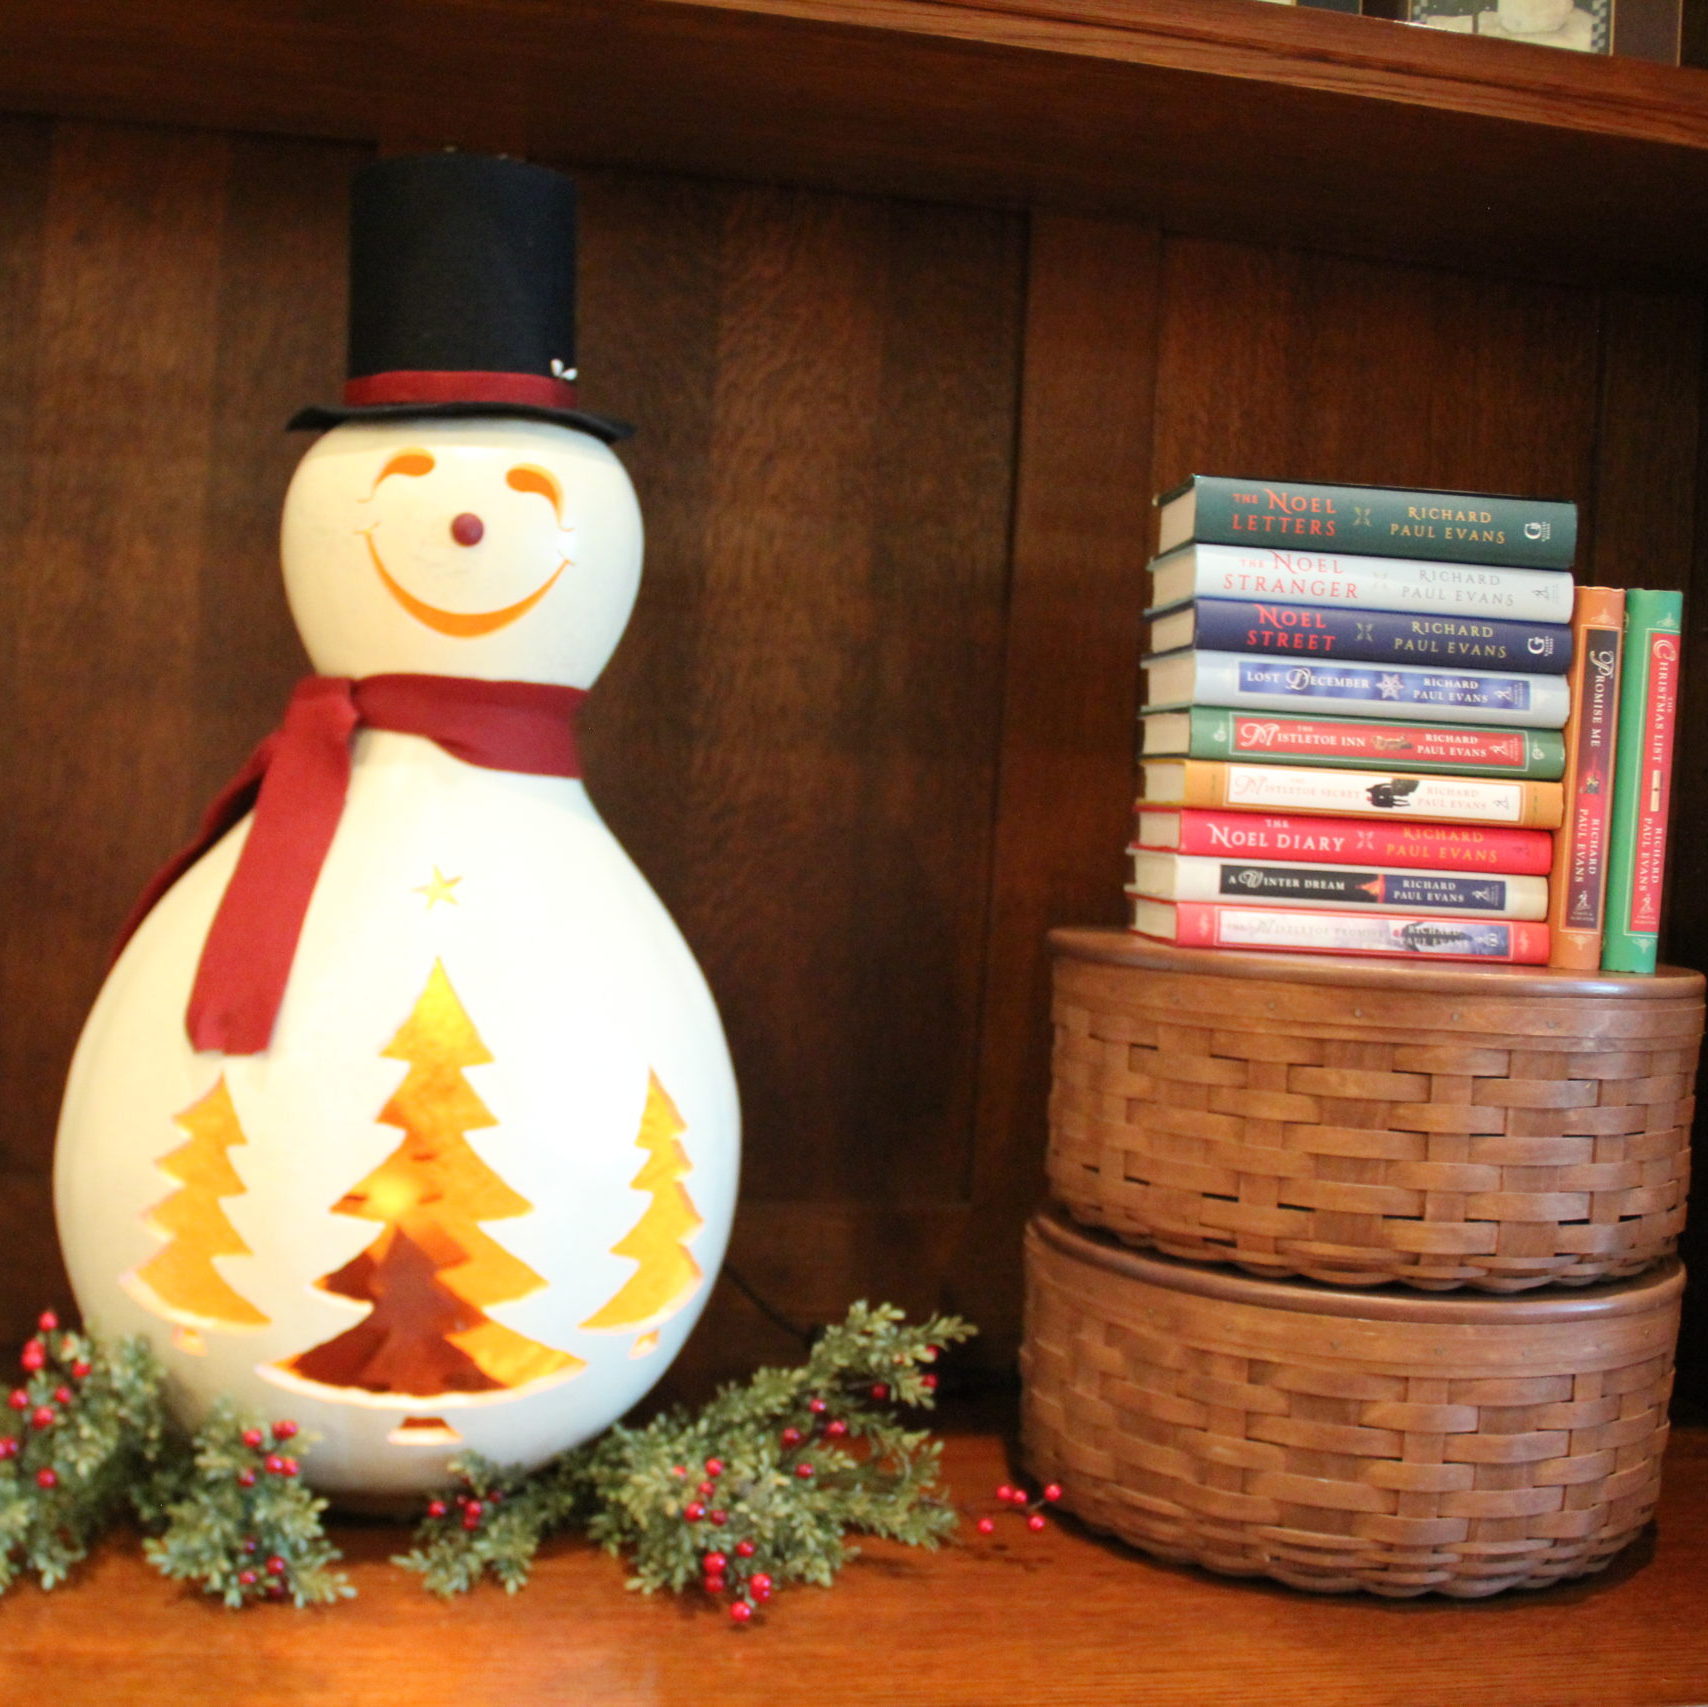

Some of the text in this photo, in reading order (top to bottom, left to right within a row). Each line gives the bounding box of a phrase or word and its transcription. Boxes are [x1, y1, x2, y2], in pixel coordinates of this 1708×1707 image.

[1232, 488, 1337, 514] THE NOEL
[1232, 514, 1336, 536] LETTERS
[1408, 506, 1493, 524] RICHARD
[1390, 523, 1506, 544] PAUL EVANS
[1268, 550, 1344, 574] NOEL
[1223, 573, 1358, 598] STRANGER
[1419, 570, 1501, 586] RICHARD
[1401, 586, 1514, 606] PAUL EVANS
[1252, 603, 1327, 629] NOEL
[1247, 630, 1336, 650] STREET
[1411, 621, 1494, 638] RICHARD
[1394, 638, 1507, 659] PAUL EVANS
[1247, 667, 1371, 691] LOST DECEMBER
[1424, 678, 1479, 690] RICHARD
[1413, 690, 1489, 704] PAUL EVANS
[1590, 650, 1614, 748] PROMISE ME
[1652, 639, 1676, 762] CHRISTMAS LIST
[1240, 723, 1366, 747] MISTLETOE INN
[1425, 733, 1479, 744] RICHARD
[1417, 745, 1487, 758] PAUL EVANS
[1426, 786, 1480, 798] RICHARD
[1417, 798, 1487, 810] PAUL EVANS
[1265, 819, 1290, 828] THE
[1206, 823, 1345, 852] NOEL DIARY
[1404, 828, 1485, 843] RICHARD
[1575, 808, 1589, 883] PAUL EVANS
[1386, 844, 1498, 863] PAUL EVANS
[1588, 818, 1600, 875] RICHARD
[1639, 818, 1653, 892] PAUL EVANS
[1651, 827, 1662, 884] RICHARD
[1228, 870, 1346, 891] A WINTER DREAM
[1402, 879, 1456, 891] RICHARD
[1394, 890, 1465, 903] PAUL EVANS
